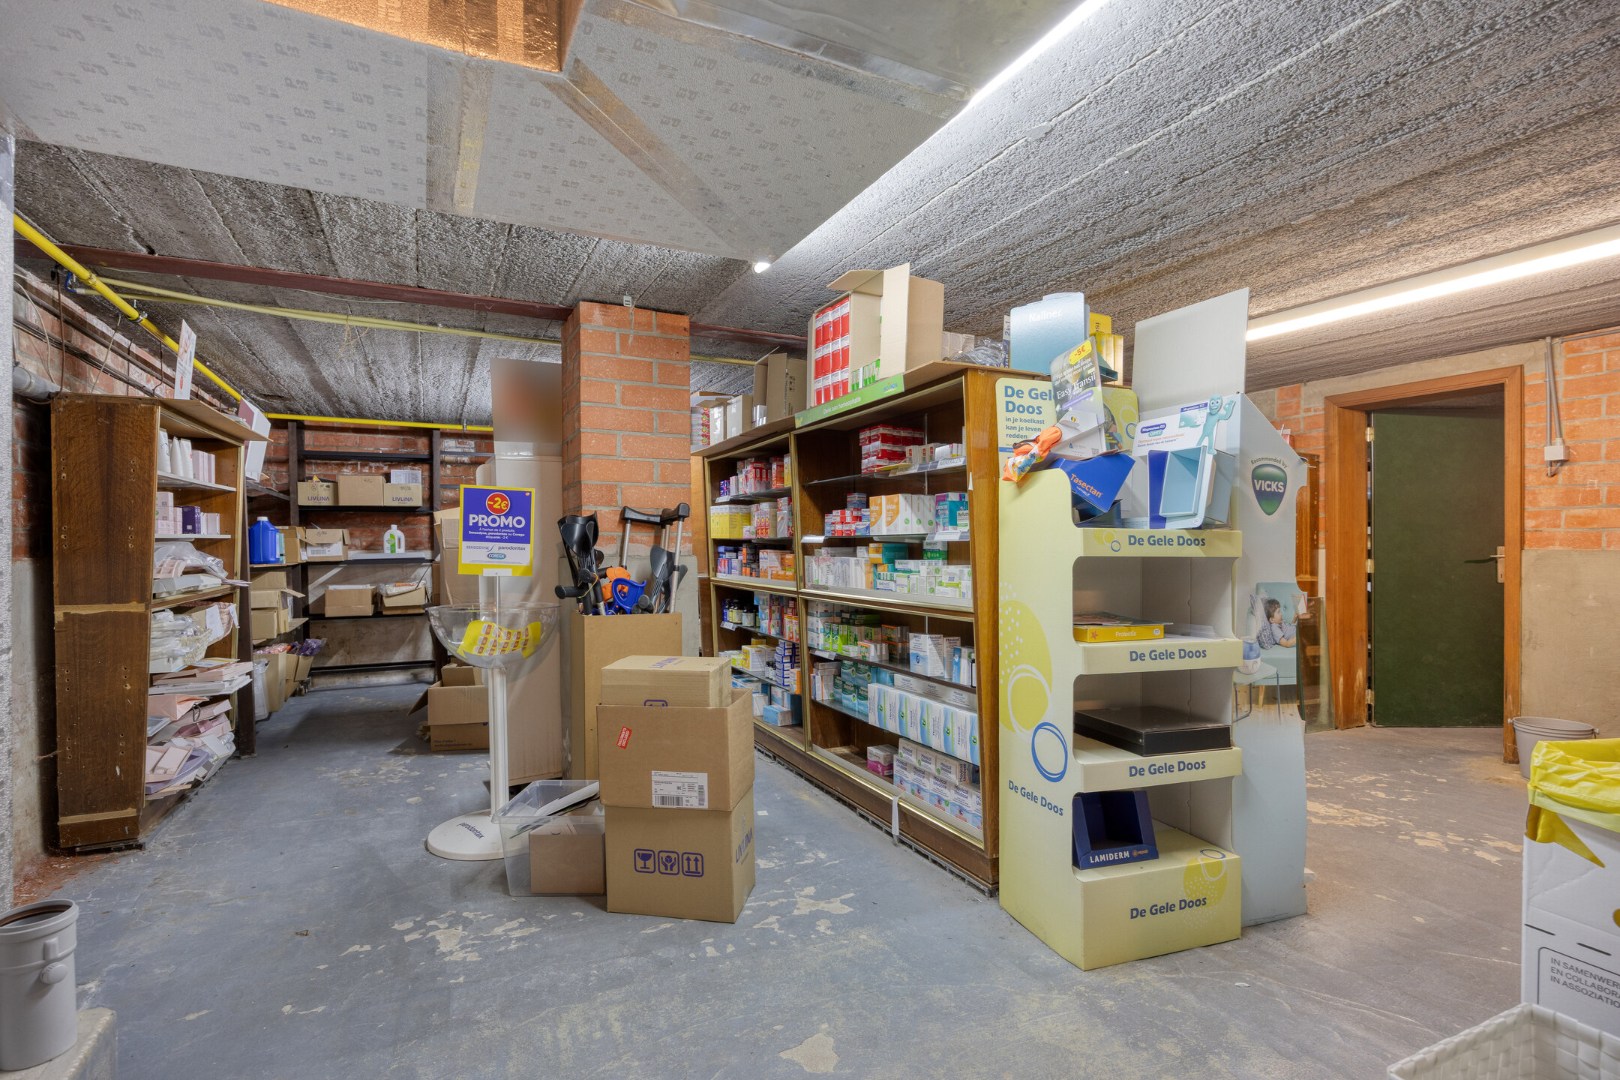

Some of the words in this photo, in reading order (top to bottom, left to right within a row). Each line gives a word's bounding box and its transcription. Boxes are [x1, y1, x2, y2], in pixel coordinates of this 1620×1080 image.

[1004, 386, 1024, 399] De
[1028, 387, 1055, 401] Gel
[1005, 401, 1043, 415] Doos
[1019, 417, 1045, 425] koelkast
[1071, 473, 1103, 498] Tasectan
[1253, 479, 1285, 493] VICKS
[487, 497, 508, 510] -2€
[468, 514, 526, 528] PROMO
[1128, 535, 1145, 546] De
[1147, 534, 1174, 546] Gele
[1176, 535, 1206, 547] Doos
[1129, 650, 1146, 662] De
[1149, 648, 1175, 661] Gele
[1178, 648, 1207, 660] Doos
[1129, 766, 1145, 777] De
[1148, 762, 1175, 775] Gele
[1177, 760, 1206, 771] Doos
[1008, 779, 1019, 793] De
[1020, 786, 1039, 804] Gele
[1040, 796, 1064, 816] Doos
[1089, 851, 1130, 863] LAMIDERM
[1130, 907, 1147, 920] De
[1149, 903, 1176, 916] Gele
[1179, 896, 1207, 910] Doos
[1550, 957, 1560, 966] IN
[1550, 966, 1563, 976] EN
[1550, 975, 1560, 985] IN
